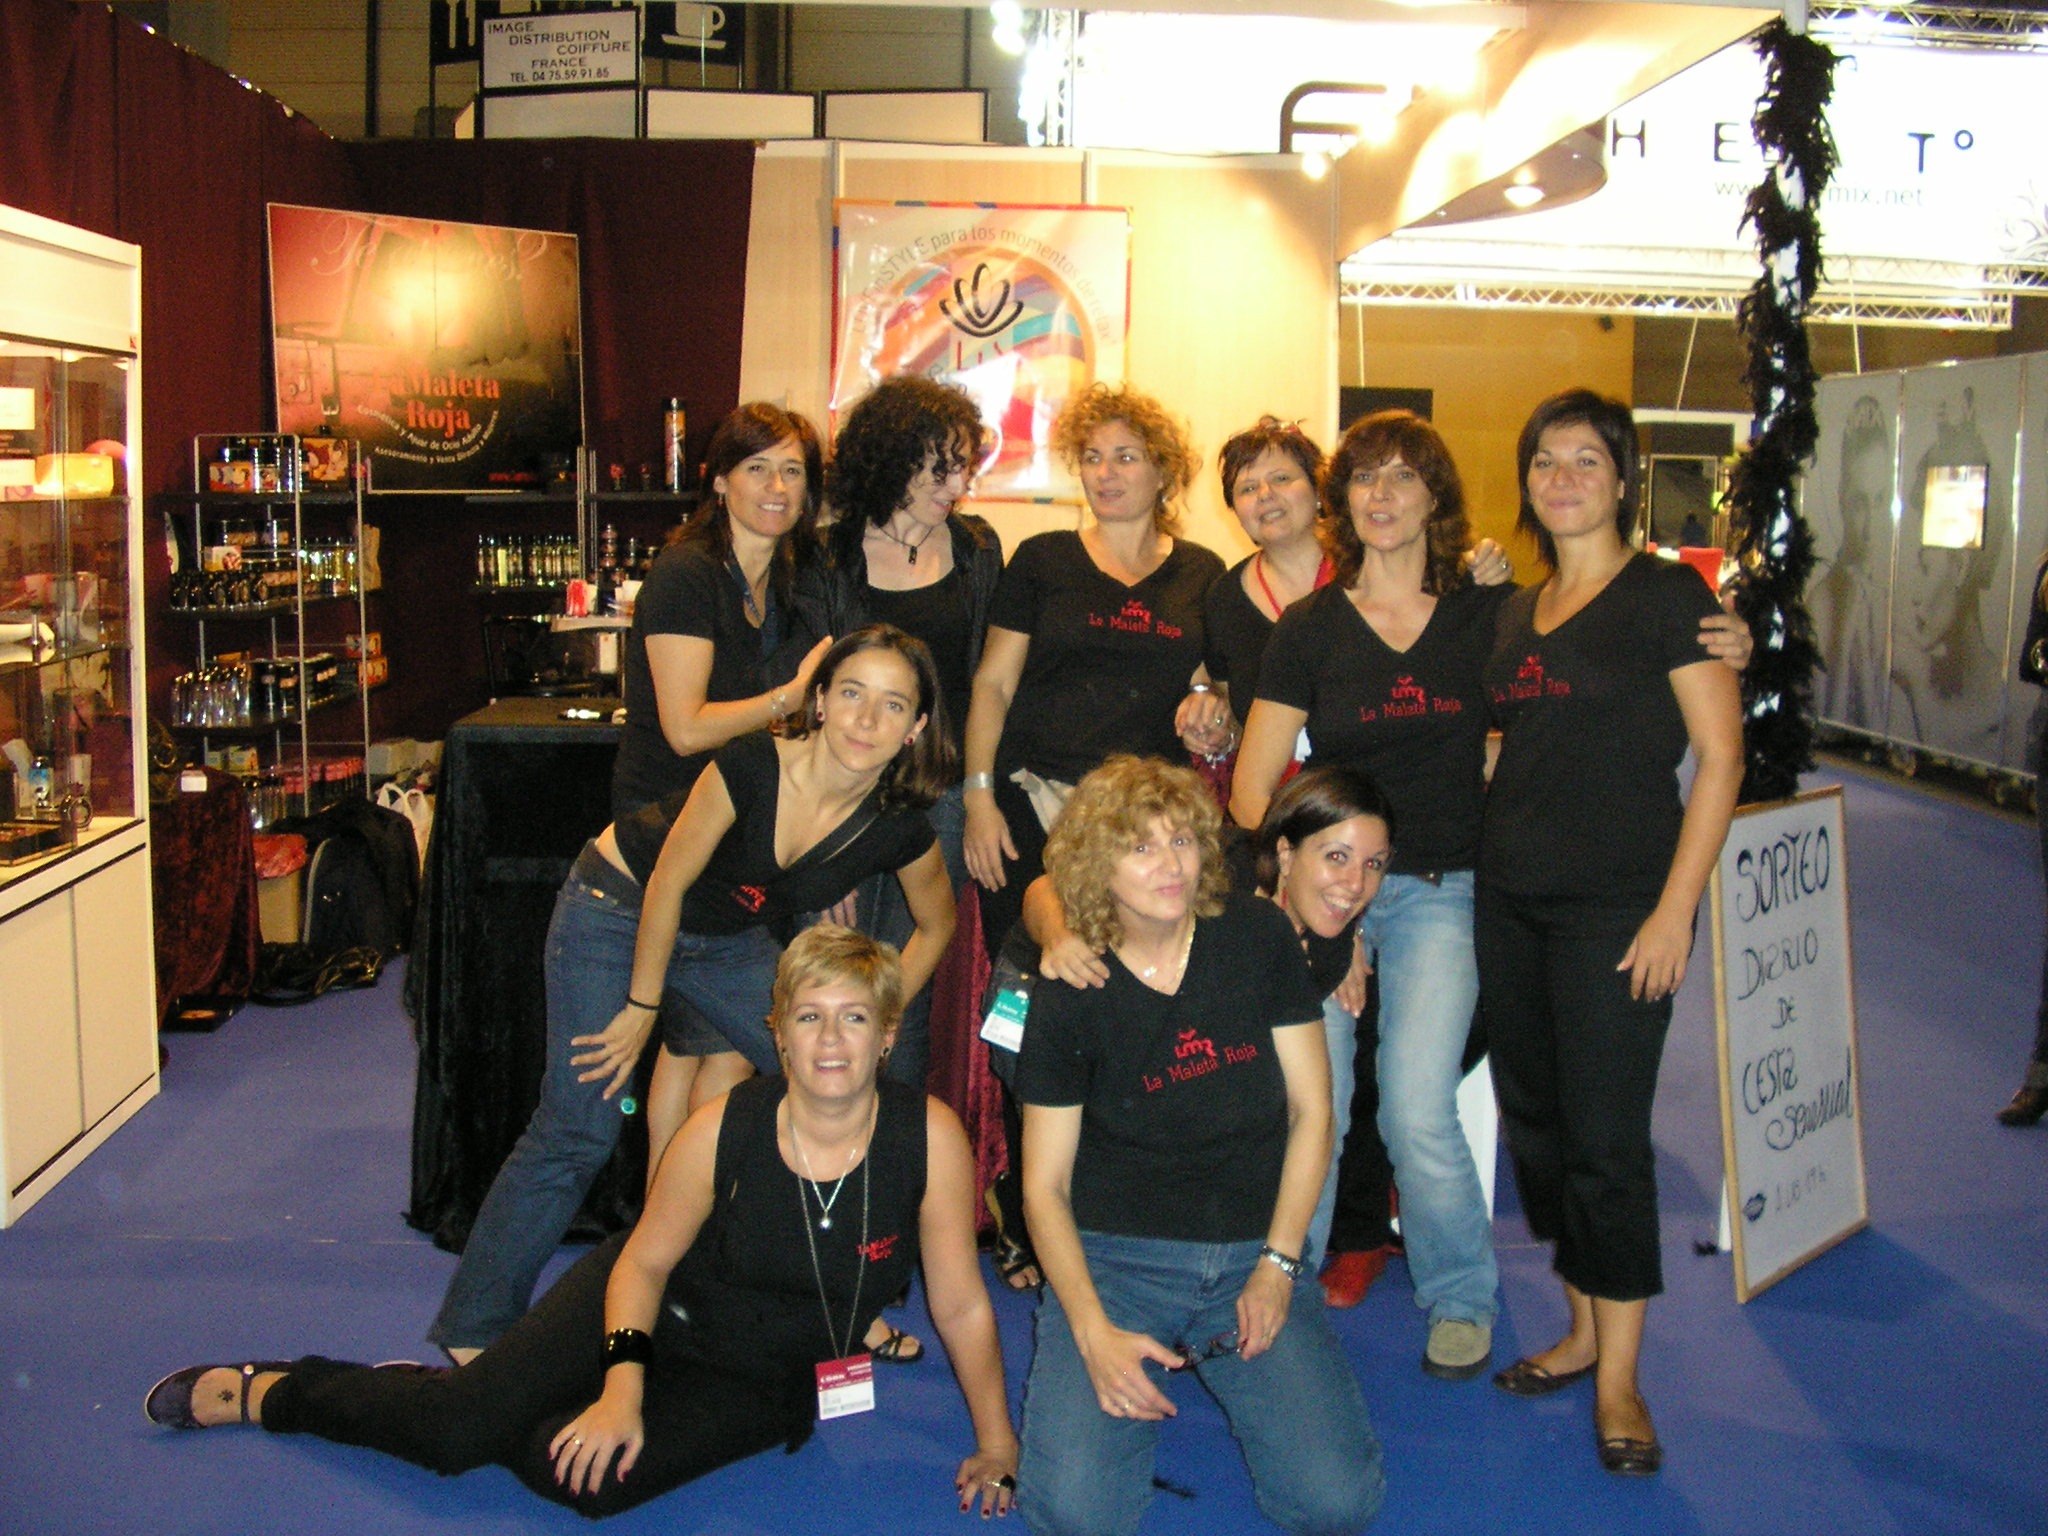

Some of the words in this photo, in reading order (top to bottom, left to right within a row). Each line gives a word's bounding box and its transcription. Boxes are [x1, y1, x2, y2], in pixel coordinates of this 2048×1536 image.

[488, 21, 534, 34] IMAGE
[509, 30, 610, 46] DISTRIBUTION
[557, 41, 631, 55] COIFFURE
[532, 57, 587, 69] FRANCE
[532, 71, 546, 81] 04
[929, 228, 967, 252] para
[970, 223, 996, 241] los
[407, 400, 471, 439] Roja
[1089, 613, 1103, 627] La
[1360, 706, 1376, 723] La
[1383, 702, 1426, 719] Maleta
[1433, 698, 1462, 715] Roja
[1736, 825, 1830, 922] SORTEO
[1771, 997, 1798, 1029] DE
[1142, 1073, 1164, 1093] La
[1167, 1057, 1218, 1083] Maleta
[1223, 1042, 1258, 1065] Roja
